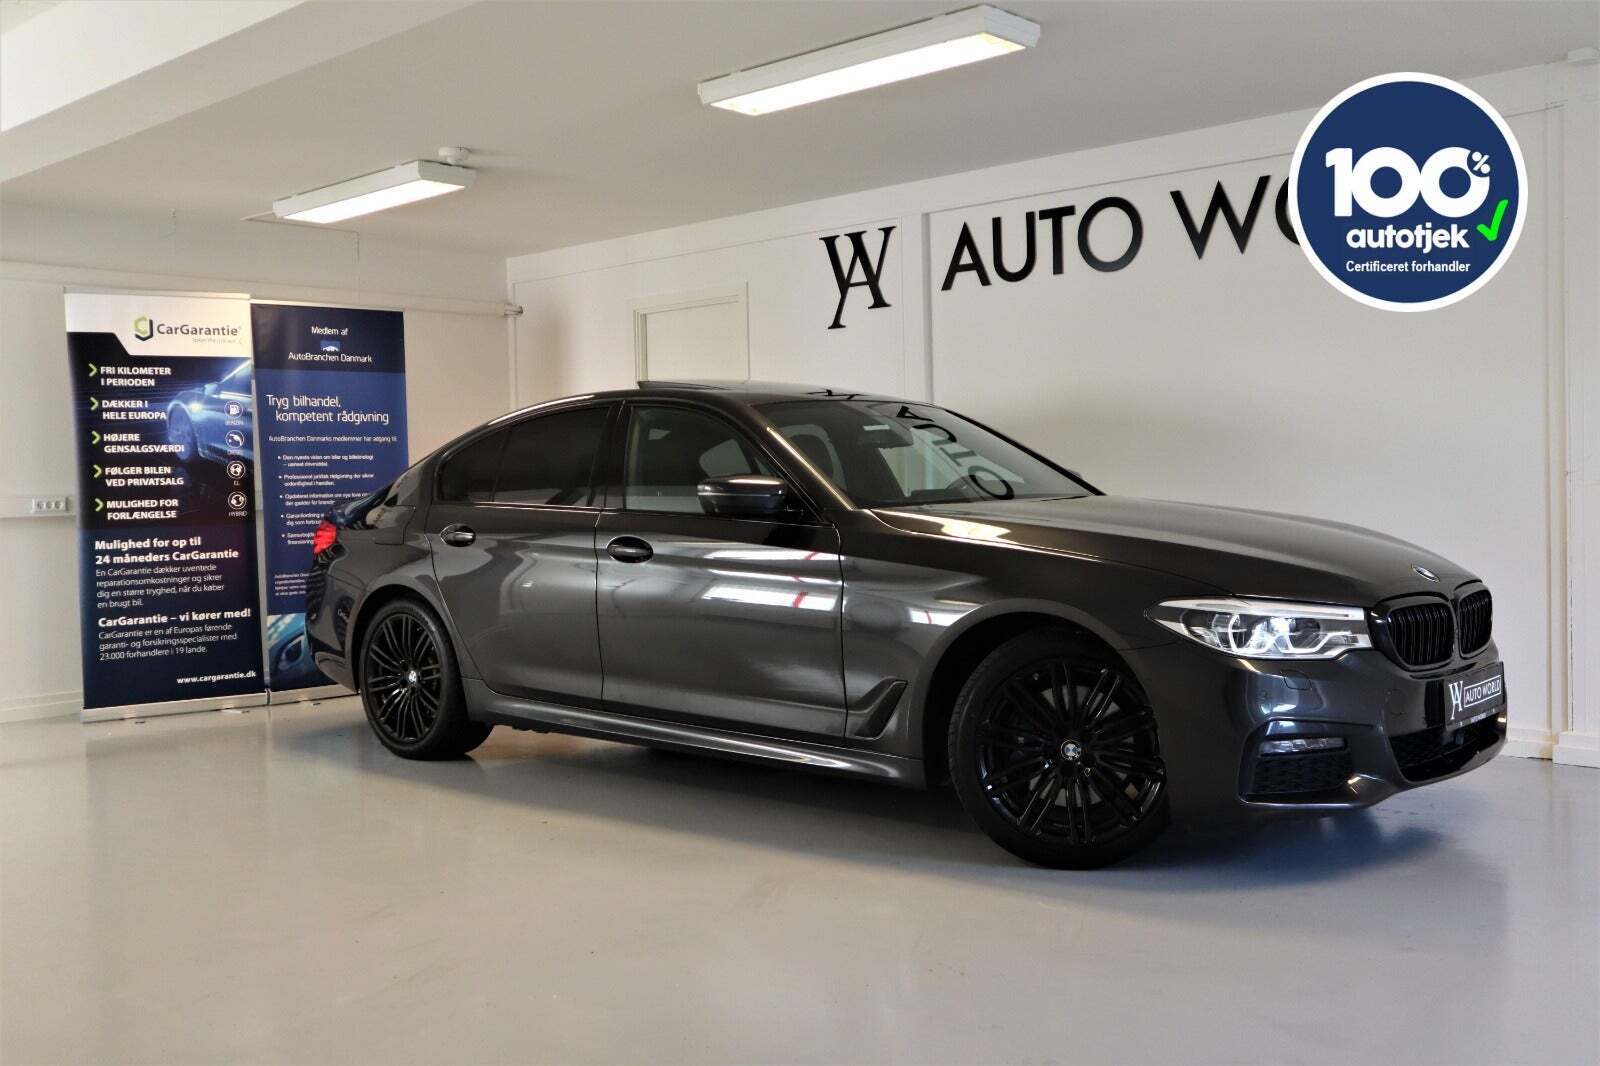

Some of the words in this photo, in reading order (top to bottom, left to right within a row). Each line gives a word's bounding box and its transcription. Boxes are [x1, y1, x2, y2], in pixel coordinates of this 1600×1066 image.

[941, 197, 1143, 291] AUTO
[1170, 175, 1299, 260] W
[157, 323, 238, 336] CarGarantie
[312, 326, 338, 335] Medlem
[288, 352, 339, 362] AutoBranchen
[341, 354, 372, 363] Danmark
[101, 366, 115, 374] FRI
[118, 366, 171, 375] KILOMETER
[107, 378, 155, 386] PERIODEN
[102, 400, 142, 408] DÆKKER
[266, 394, 288, 409] Tryg
[103, 412, 126, 420] HELE
[129, 412, 167, 420] EUROPA
[276, 410, 333, 424] kompetent
[338, 410, 388, 425] rådgivning
[104, 433, 140, 441] HØJERE
[104, 445, 184, 453] GENSALGSVÆRDI
[105, 467, 142, 475] FØLGER
[144, 466, 171, 474] BILEN
[106, 478, 125, 487] VED
[128, 478, 184, 486] PRIVATSALG
[107, 500, 157, 509] MULIGHED
[108, 511, 177, 520] FORLÆNGELSE
[95, 539, 150, 551] Mulighed
[152, 538, 170, 548] for
[172, 539, 187, 550] op
[189, 537, 201, 546] til
[96, 556, 110, 565] 24
[113, 550, 170, 564] måneders
[172, 550, 239, 562] CarGarantie
[108, 567, 151, 576] CarGarantie
[98, 614, 167, 627] CarGarantie
[179, 612, 189, 621] vi
[192, 609, 222, 620] kører
[224, 608, 251, 618] med!
[99, 629, 143, 639] CarGarantie
[177, 670, 256, 684] www.cargarantie.dk
[1466, 687, 1481, 702] AUTO
